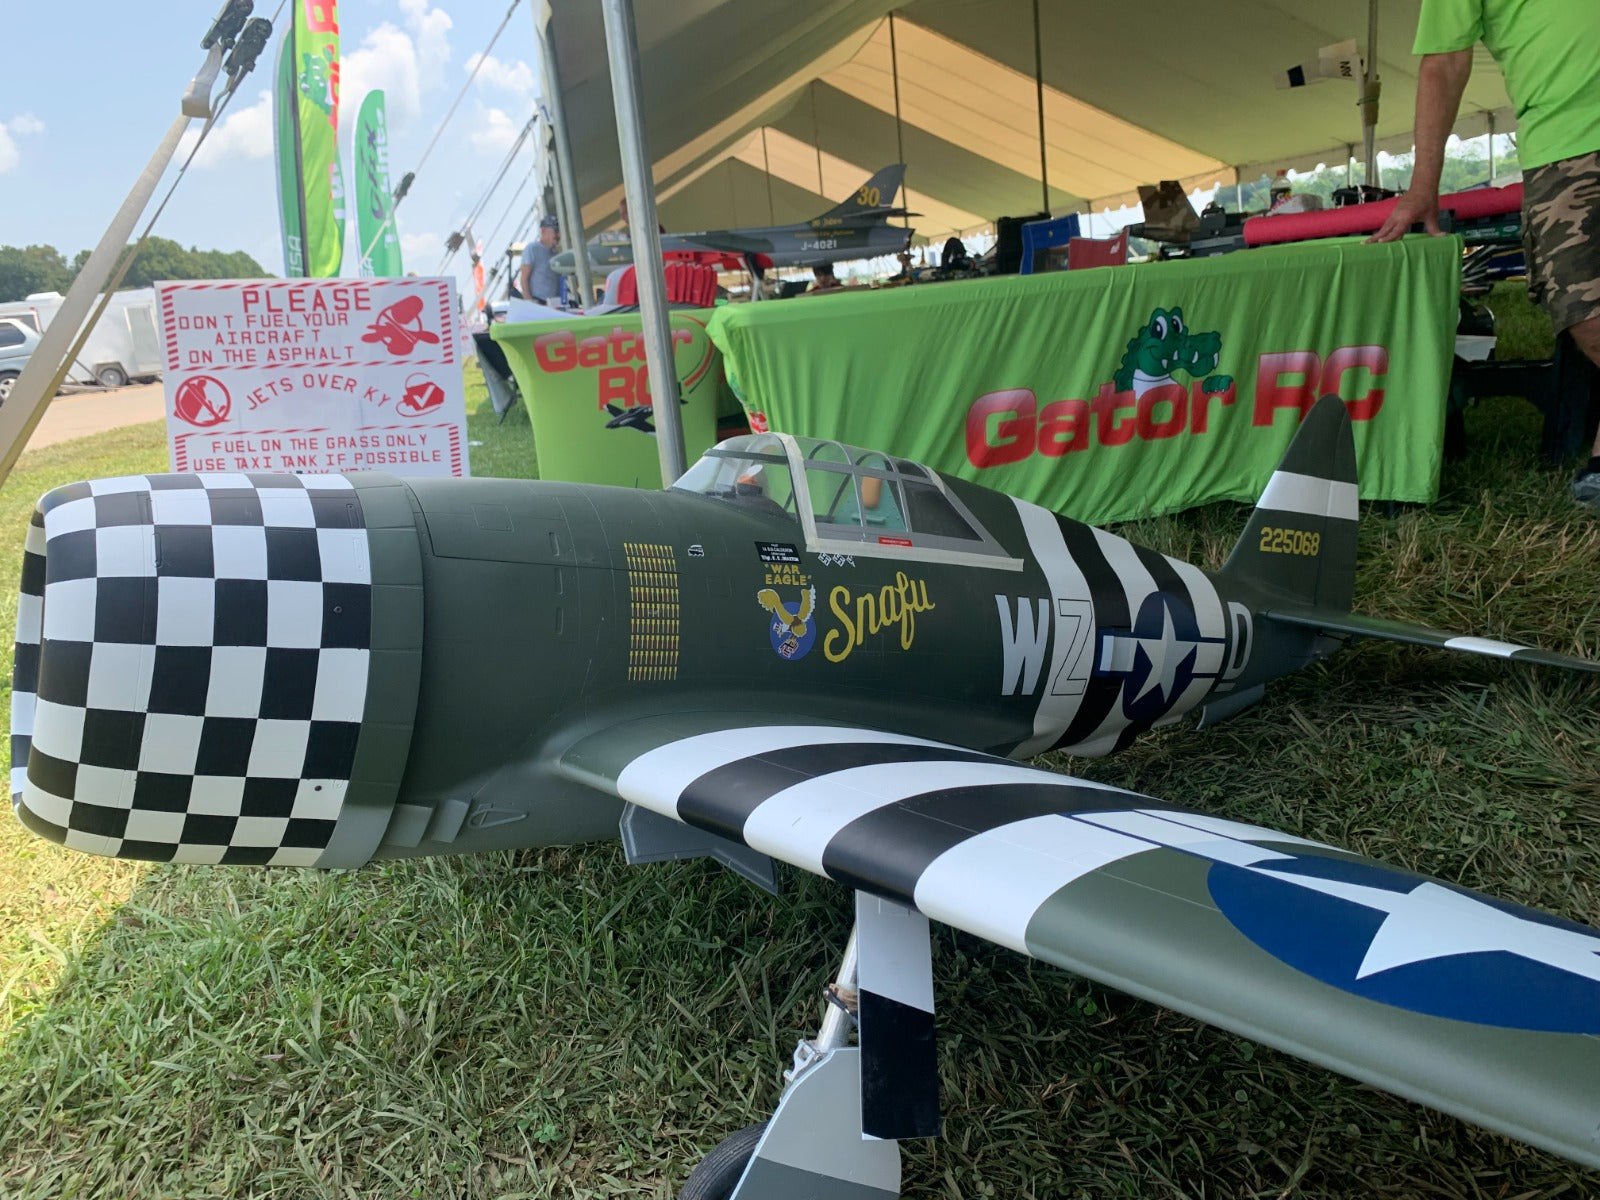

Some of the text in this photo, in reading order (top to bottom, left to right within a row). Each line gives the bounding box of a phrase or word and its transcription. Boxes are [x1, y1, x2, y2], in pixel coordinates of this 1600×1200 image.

[857, 185, 880, 207] 30
[801, 239, 837, 251] J-4021
[242, 289, 371, 313] PLEASE
[246, 314, 296, 328] FUEL
[303, 312, 349, 326] YOUR
[215, 329, 320, 345] AIRCRAFT
[189, 345, 353, 363] ON THE ASPHALT
[533, 326, 692, 373] Gatr
[246, 373, 392, 410] JETS OVER KY
[965, 344, 1389, 469] Gator RC
[212, 434, 428, 453] FUEL ON THE GRASS ONLY
[193, 450, 442, 471] USE TAXI TANK IF POSSIBLE
[1259, 526, 1321, 557] 225068
[824, 571, 935, 663] Snafu
